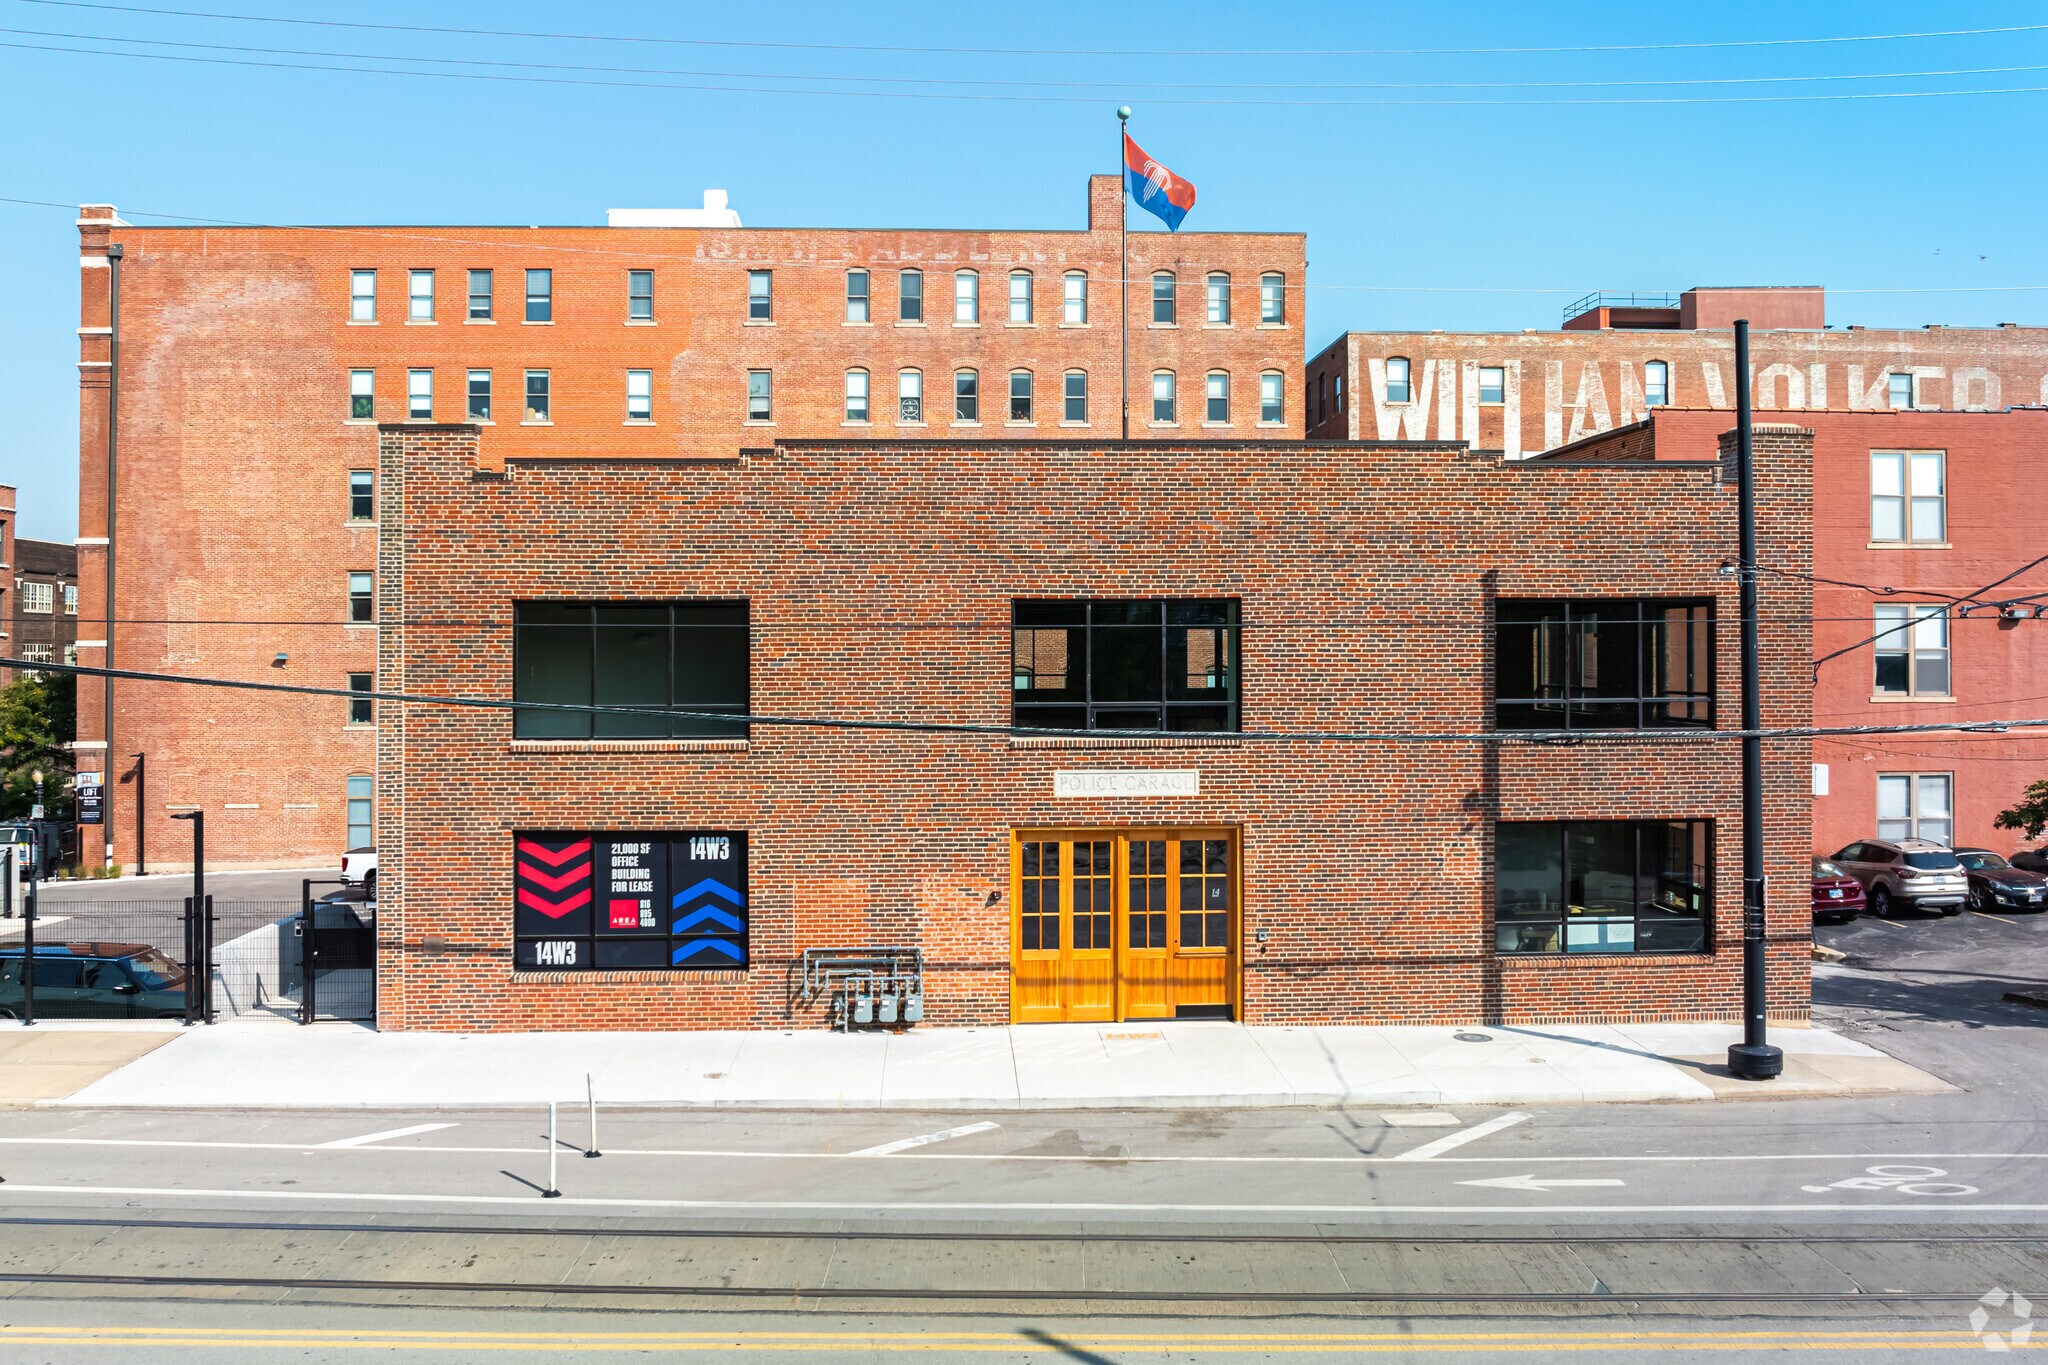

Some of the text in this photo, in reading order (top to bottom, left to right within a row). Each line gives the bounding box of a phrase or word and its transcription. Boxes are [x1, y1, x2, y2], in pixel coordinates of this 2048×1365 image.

[1059, 775, 1195, 791] POLICE GARAGE
[84, 788, 97, 796] LOFT
[611, 843, 651, 855] 21,000 SF
[690, 836, 730, 860] 14W3
[611, 856, 639, 867] OFFICE
[611, 868, 650, 879] BUILDING
[611, 881, 653, 892] FOR LEASE
[640, 900, 651, 909] 816
[535, 941, 576, 965] 14W3
